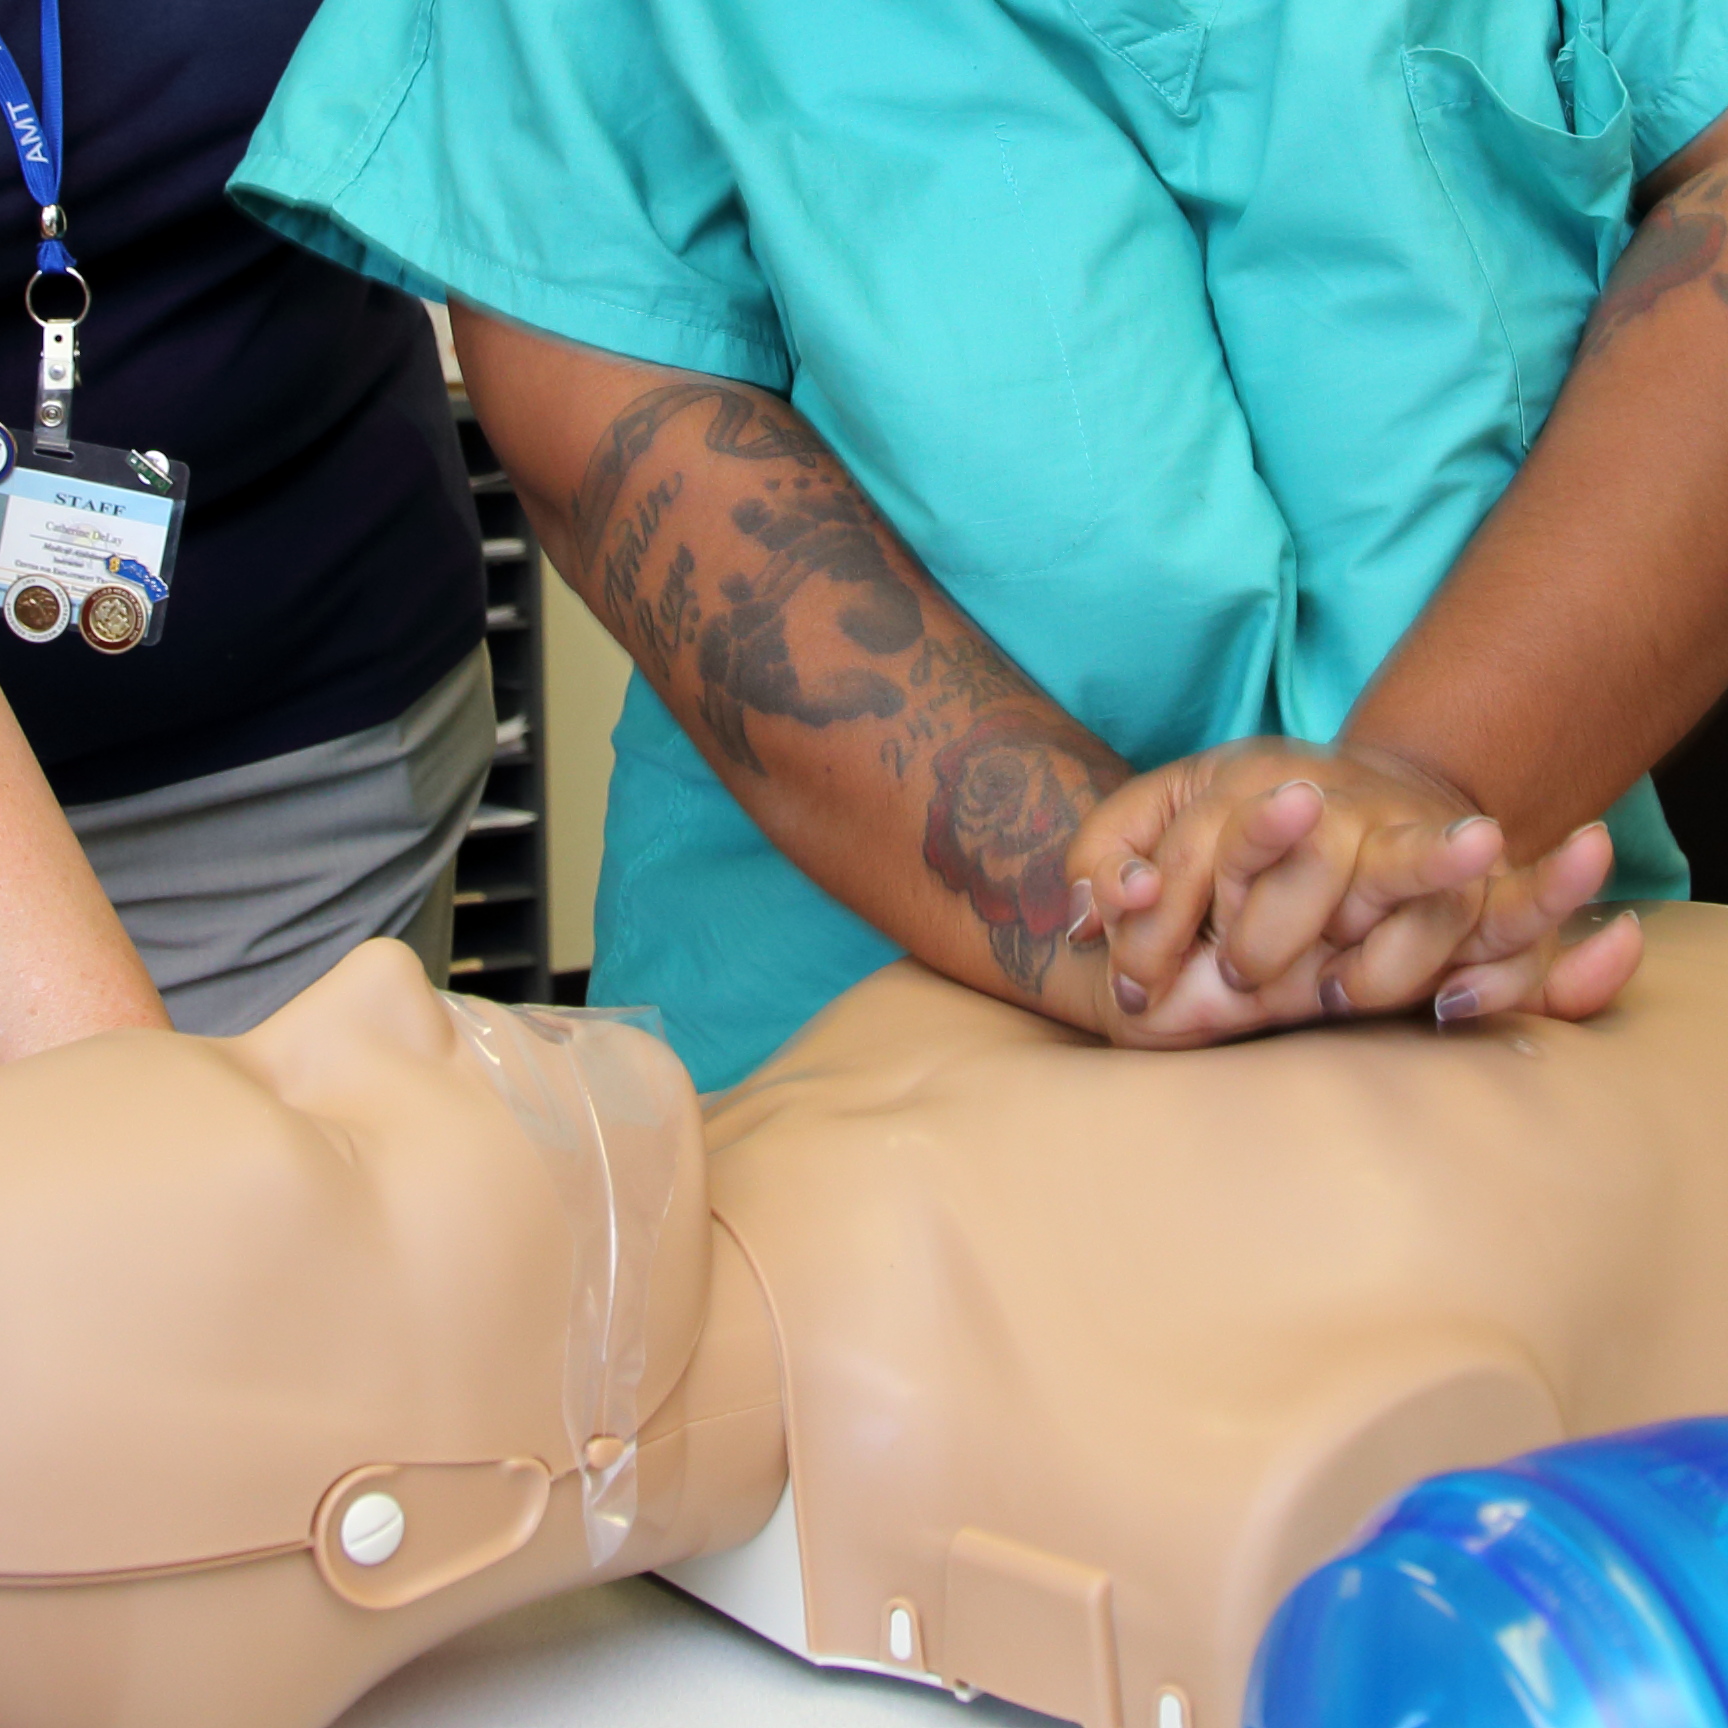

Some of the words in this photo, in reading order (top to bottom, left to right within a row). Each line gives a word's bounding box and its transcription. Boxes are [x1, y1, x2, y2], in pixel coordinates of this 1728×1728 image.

[7, 101, 49, 164] AMT
[54, 492, 126, 516] STAFF
[45, 521, 90, 539] Catherine
[91, 530, 123, 545] DeLay
